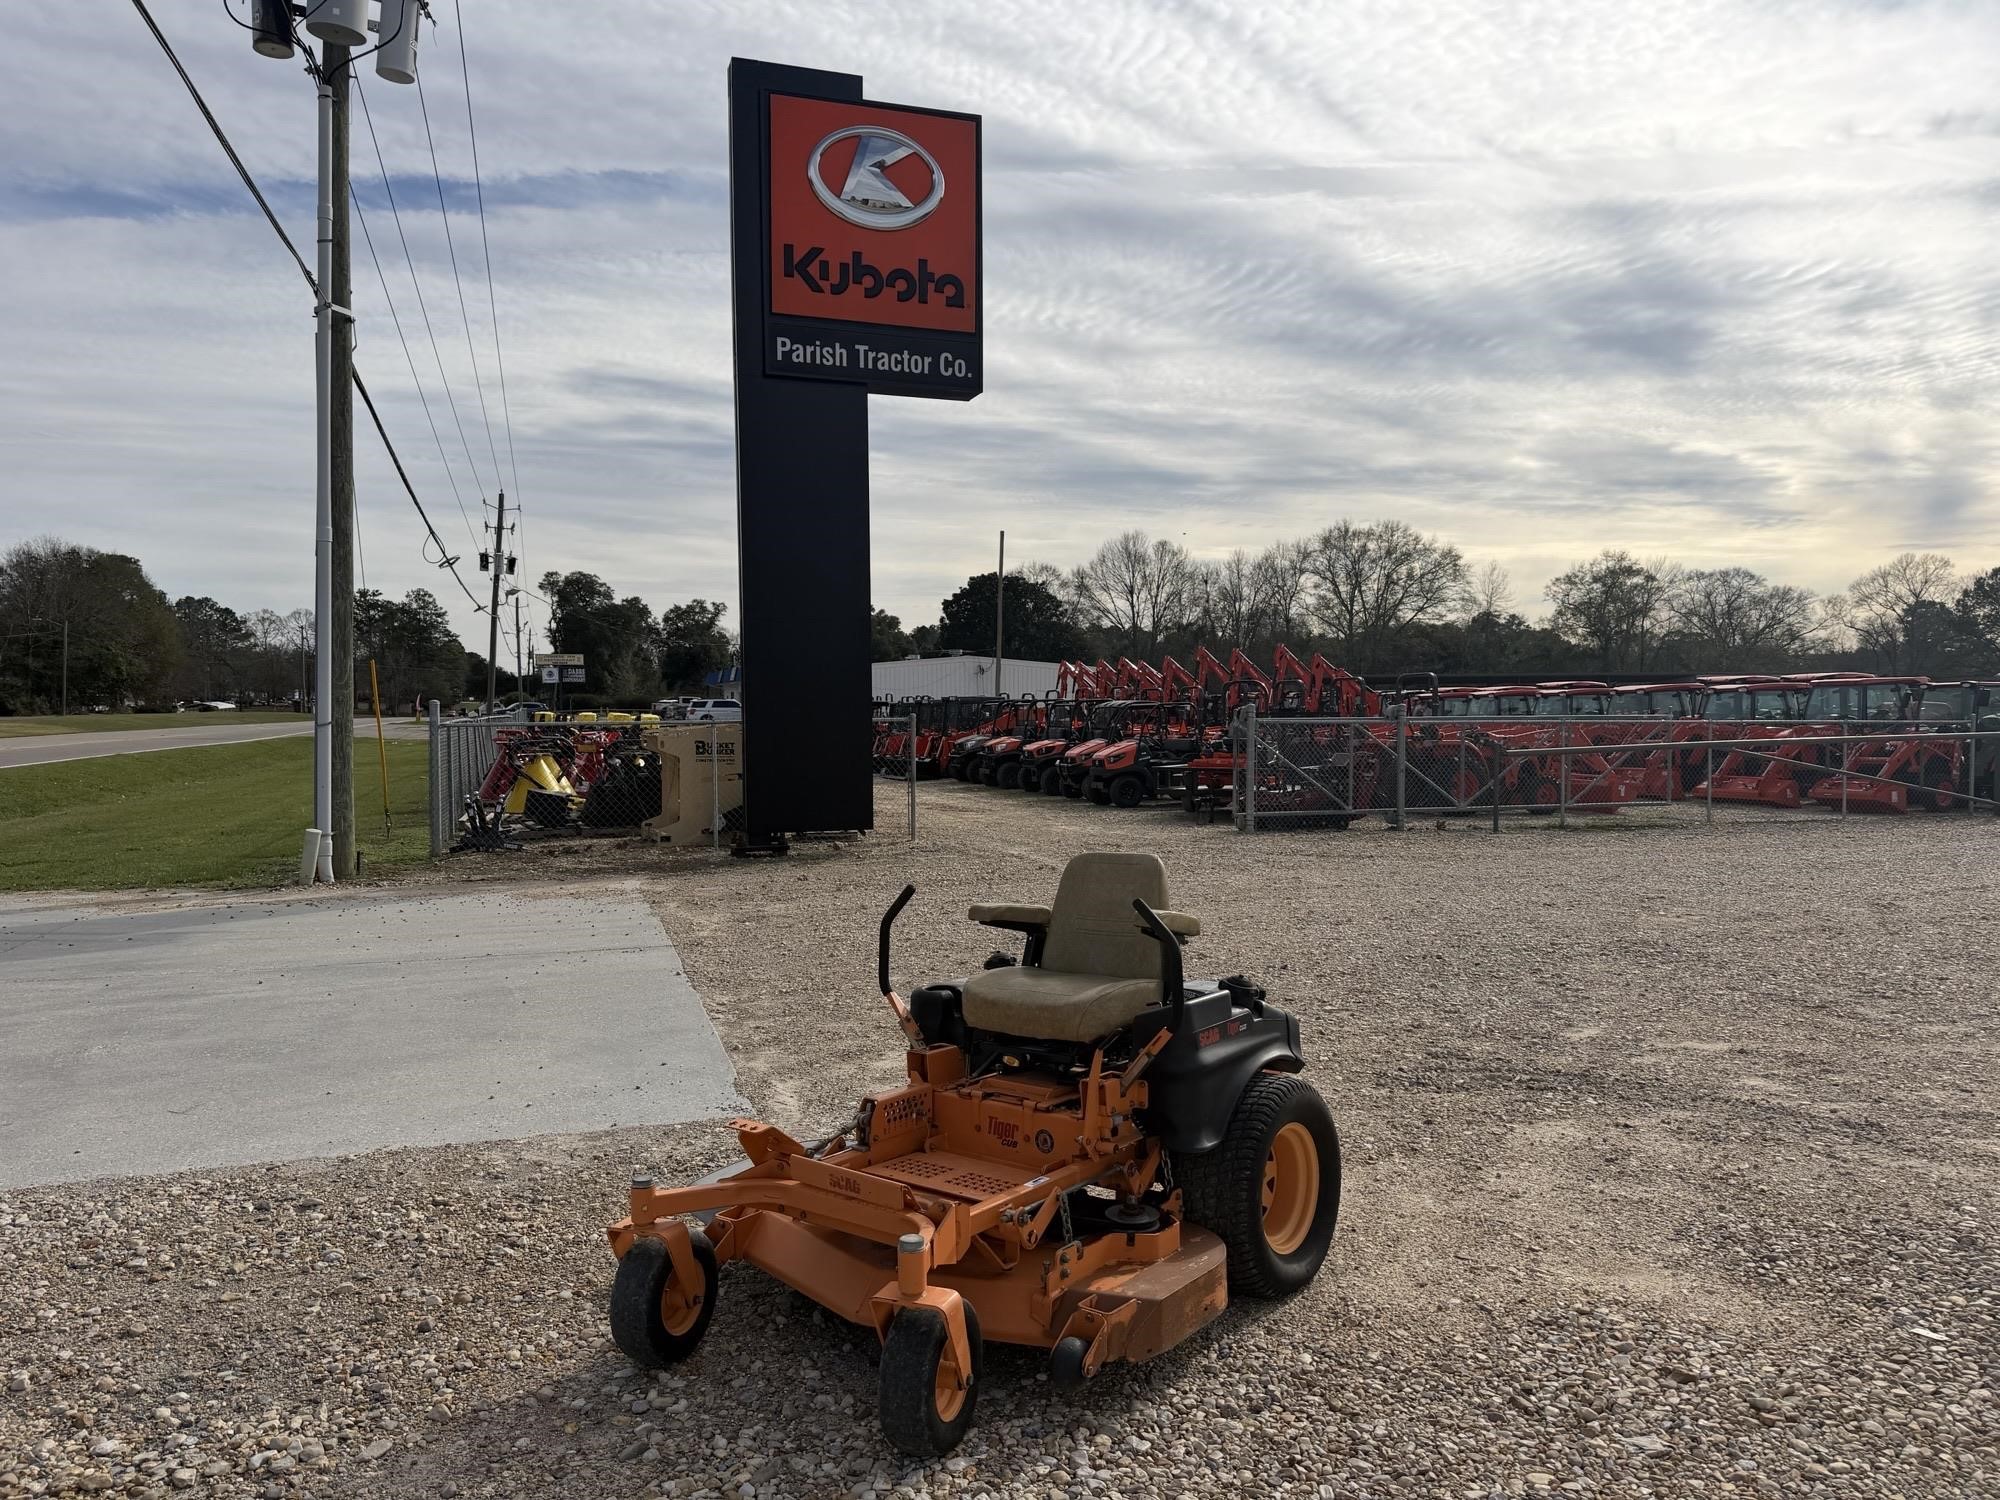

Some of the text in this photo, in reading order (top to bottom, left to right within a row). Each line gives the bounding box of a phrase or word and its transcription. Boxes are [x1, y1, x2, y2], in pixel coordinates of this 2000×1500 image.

[783, 243, 965, 309] Kubota
[776, 336, 973, 378] Parish Tractor Co.
[987, 1115, 1020, 1139] Tiger
[1001, 1138, 1019, 1149] CUB
